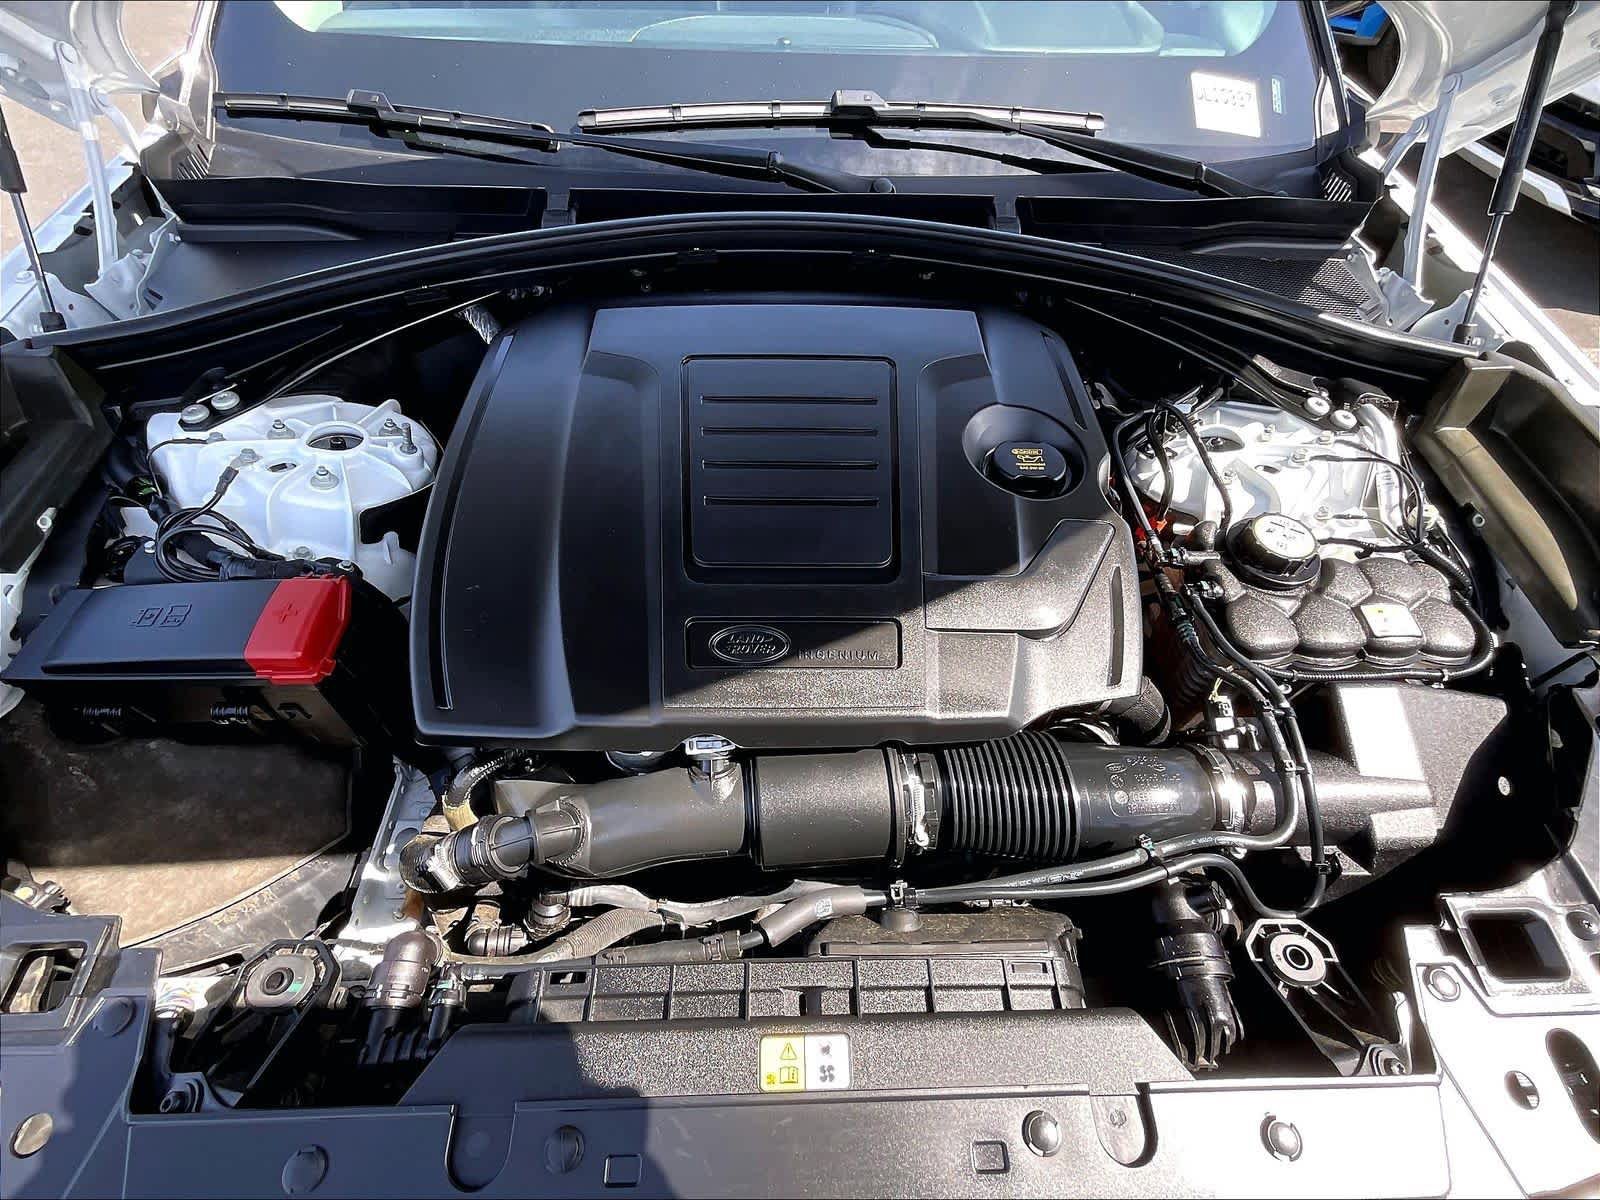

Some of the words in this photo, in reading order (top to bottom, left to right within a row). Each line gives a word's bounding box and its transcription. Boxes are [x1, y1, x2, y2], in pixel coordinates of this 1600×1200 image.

[727, 634, 766, 643] LAND
[730, 644, 776, 654] ROVER
[797, 650, 880, 661] INGENIUM
